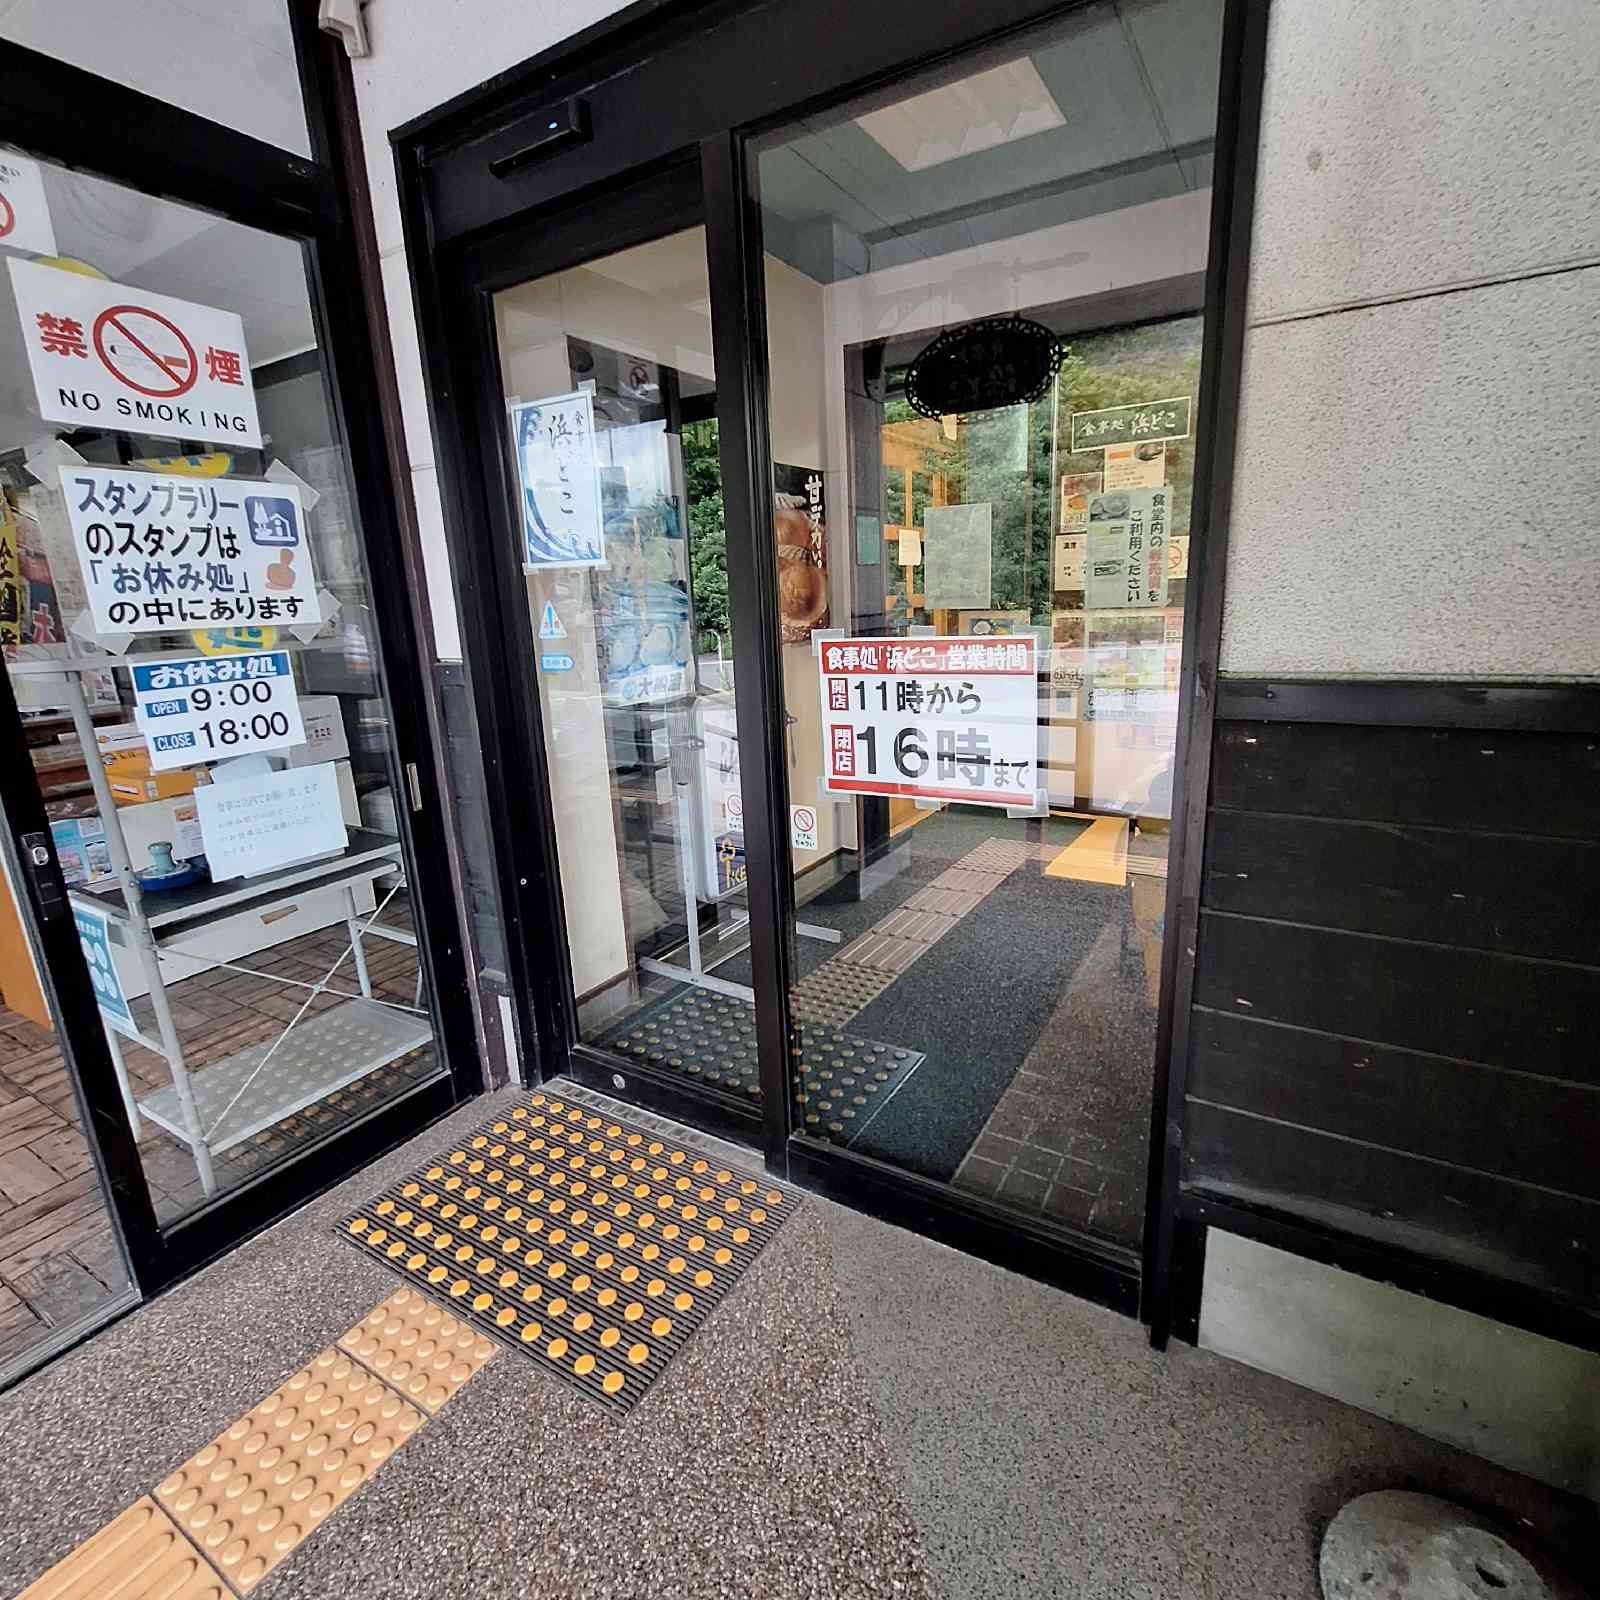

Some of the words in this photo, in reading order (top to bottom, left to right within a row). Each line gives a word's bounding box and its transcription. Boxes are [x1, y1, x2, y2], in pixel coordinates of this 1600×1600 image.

[36, 312, 89, 359] 禁
[204, 346, 244, 386] 煙
[59, 388, 101, 412] NO
[116, 398, 249, 433] SMOKING
[1132, 410, 1176, 435] 浜どこ
[74, 478, 240, 520] スタンプラリー
[85, 522, 241, 559] のスタンプは
[1127, 510, 1144, 602] ご利用ください
[1147, 493, 1166, 602] 食堂内のを
[90, 559, 250, 595] 「お休み処」
[108, 596, 304, 625] の中にあります
[150, 656, 277, 689] お休み処
[826, 644, 1027, 671] 食事処「浜どこ」営業時間
[152, 701, 181, 714] OPEN
[191, 681, 272, 712] 9:00
[831, 680, 848, 709] 開店
[854, 680, 982, 714] 11時から
[157, 733, 193, 751] CLOSE
[199, 711, 289, 748] 18:00
[834, 729, 853, 773] 閉店
